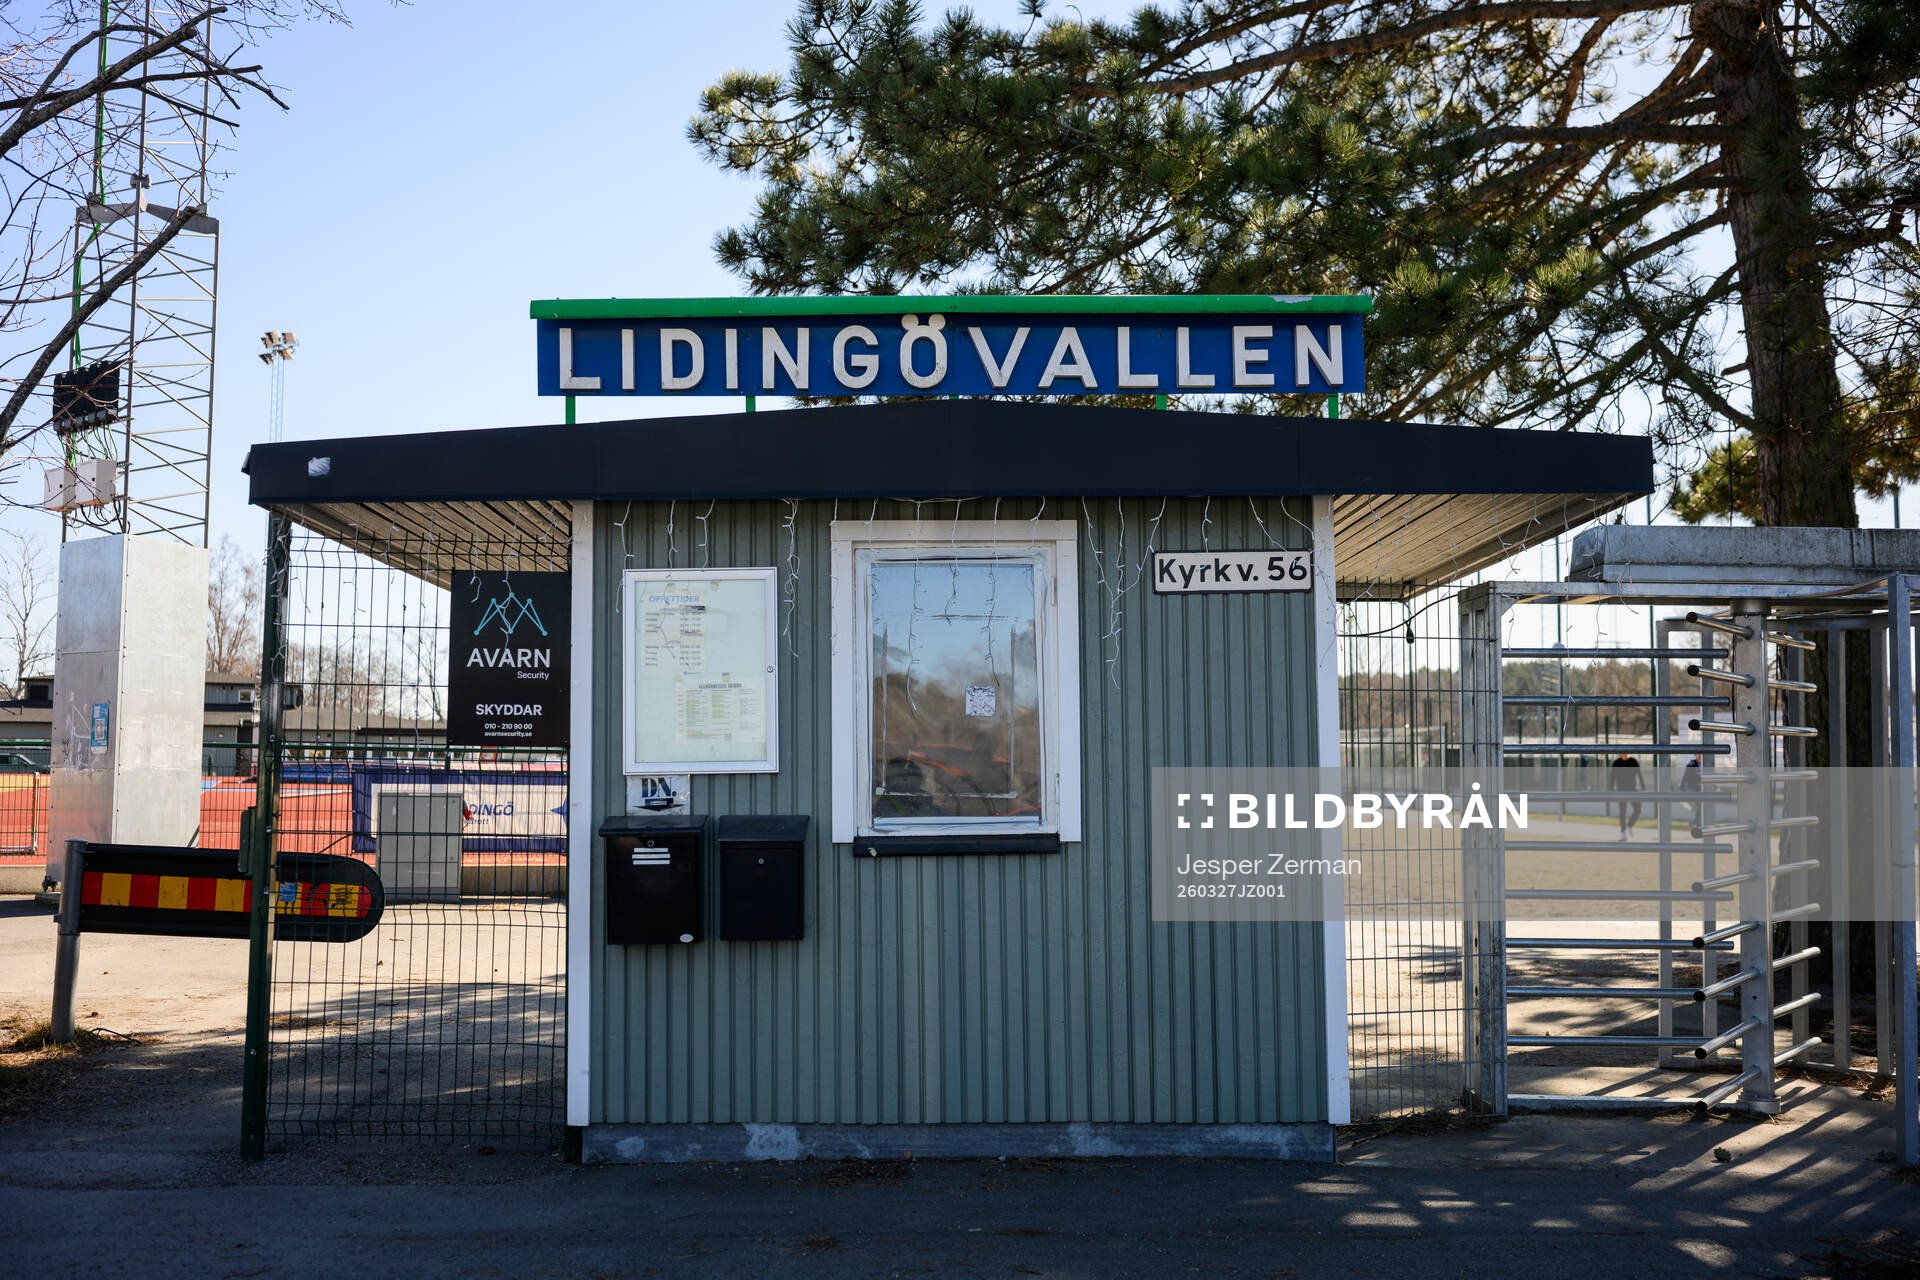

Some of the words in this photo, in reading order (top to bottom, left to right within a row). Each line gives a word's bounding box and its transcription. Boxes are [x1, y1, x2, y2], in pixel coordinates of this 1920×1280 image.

[559, 313, 1344, 390] LIDINGÖVALLEN
[1159, 558, 1259, 589] Kyrkv.
[1268, 556, 1308, 581] 56
[466, 648, 550, 668] AVARN
[517, 670, 550, 681] Security
[475, 704, 543, 716] SKYDDAR
[641, 777, 677, 798] DN.
[469, 801, 514, 816] DINGÖ
